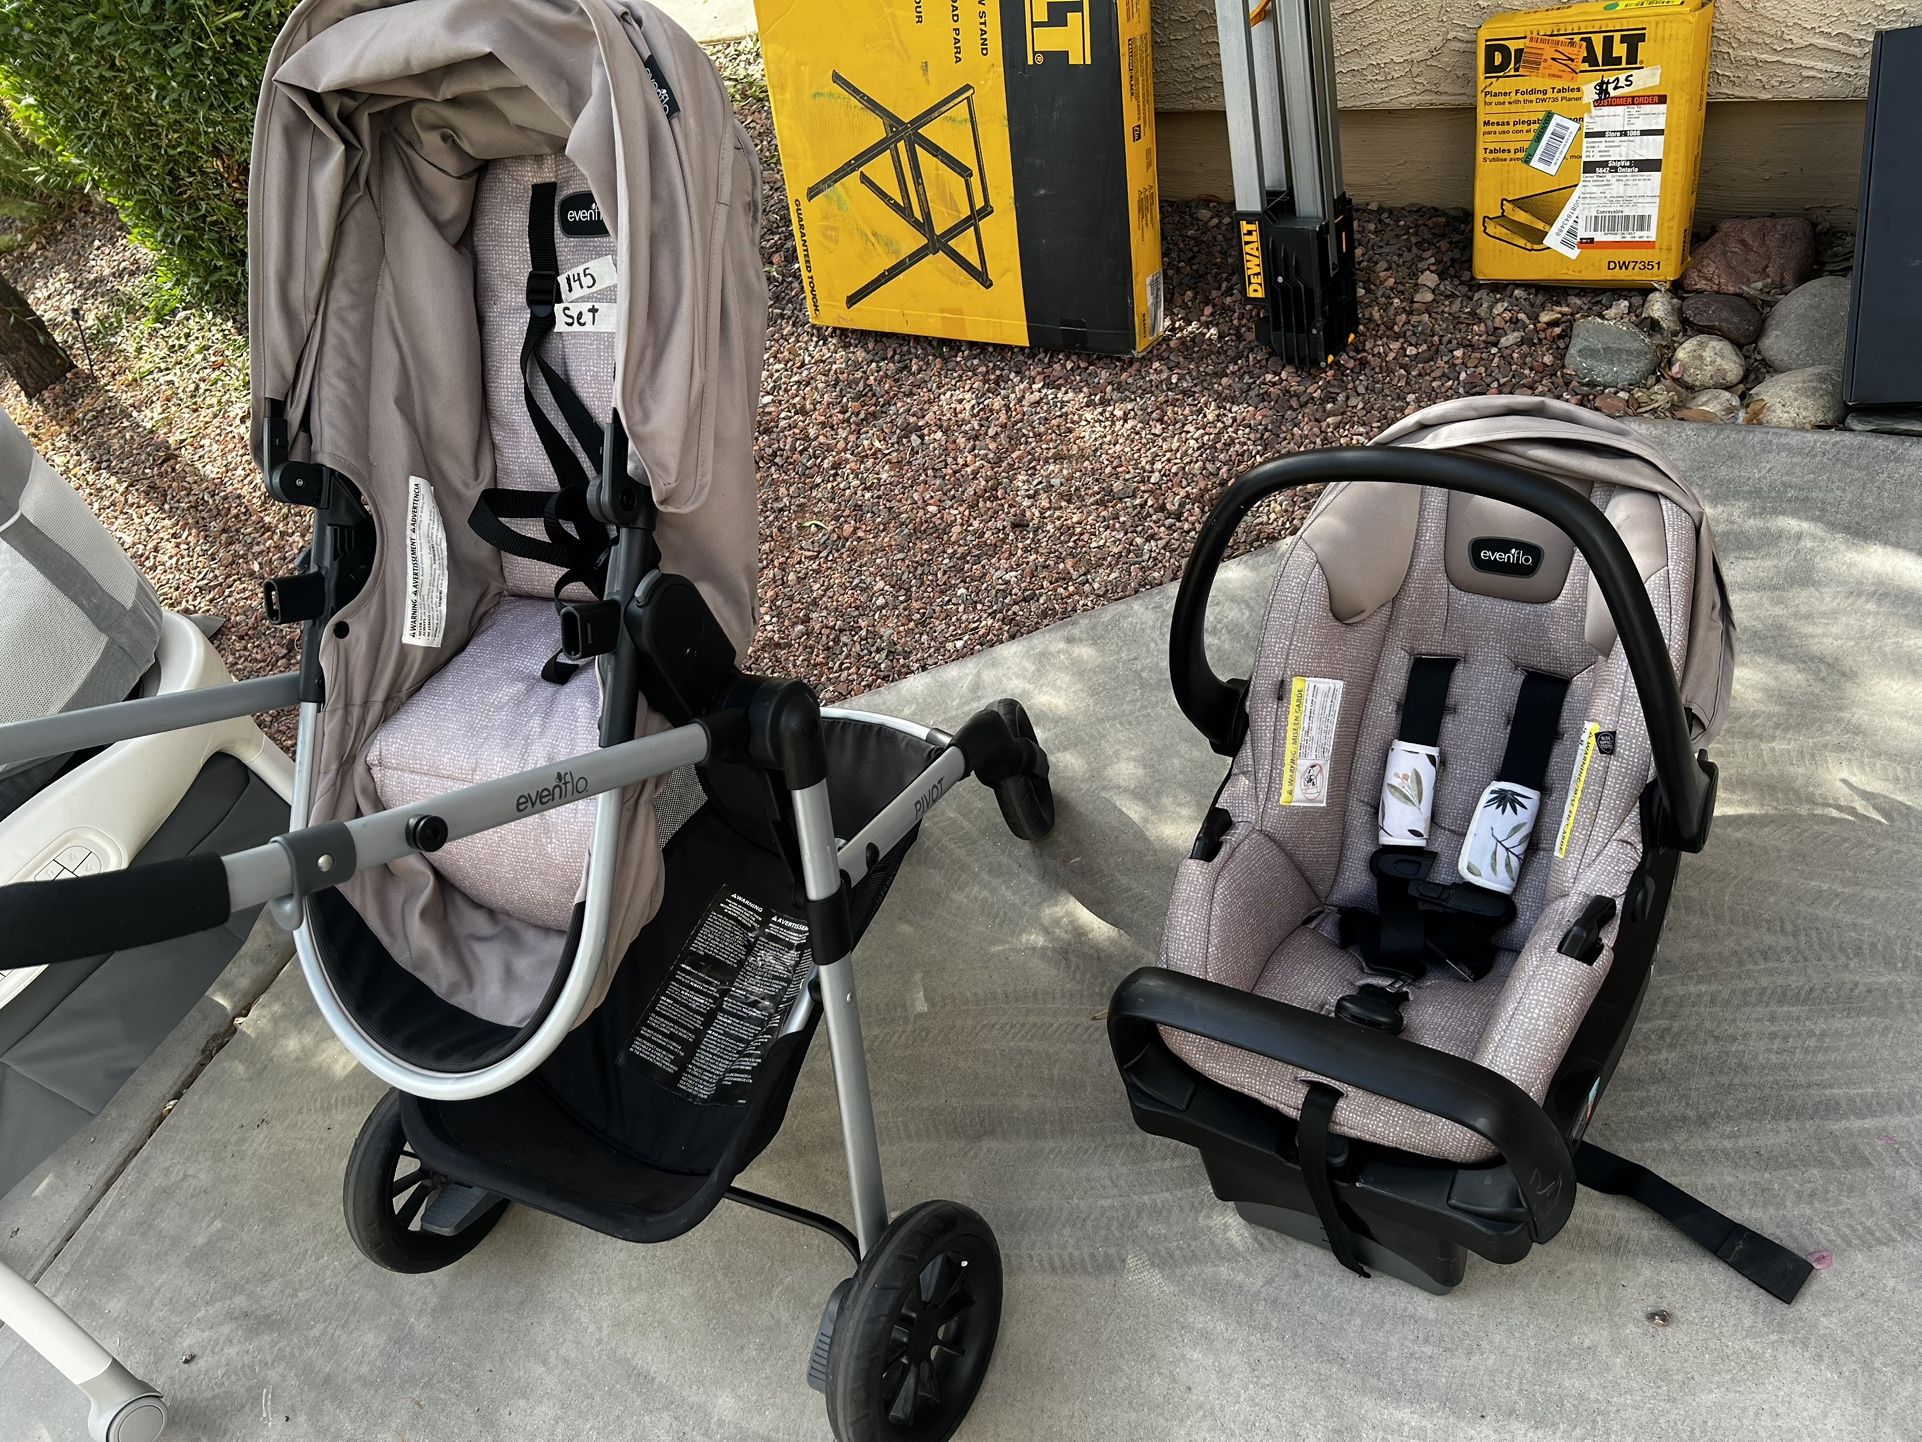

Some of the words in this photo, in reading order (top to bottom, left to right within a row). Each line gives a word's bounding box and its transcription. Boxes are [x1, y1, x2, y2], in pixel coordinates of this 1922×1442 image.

[953, 28, 962, 64] PARA
[979, 11, 989, 56] STAND
[1484, 90, 1512, 98] Planer
[1515, 88, 1548, 96] Folding
[1550, 86, 1581, 94] Tables
[1634, 96, 1659, 104] ORDER
[794, 198, 812, 273] GUARANTEED
[1242, 221, 1264, 298] DEWALT
[1607, 260, 1661, 271] DW7351
[562, 304, 599, 327] Set
[410, 483, 420, 527] ADVERTENCIA
[410, 537, 419, 589] AVERTISSEMENT
[1480, 548, 1533, 565] evenflo
[409, 599, 418, 633] WARNING
[1294, 688, 1304, 713] GARDE
[1291, 727, 1299, 746] MISE
[1294, 715, 1299, 727] EN
[1287, 750, 1296, 788] WARNING
[515, 770, 588, 813] evenflo
[914, 776, 944, 821] PIVOT
[736, 895, 763, 913] WARNING
